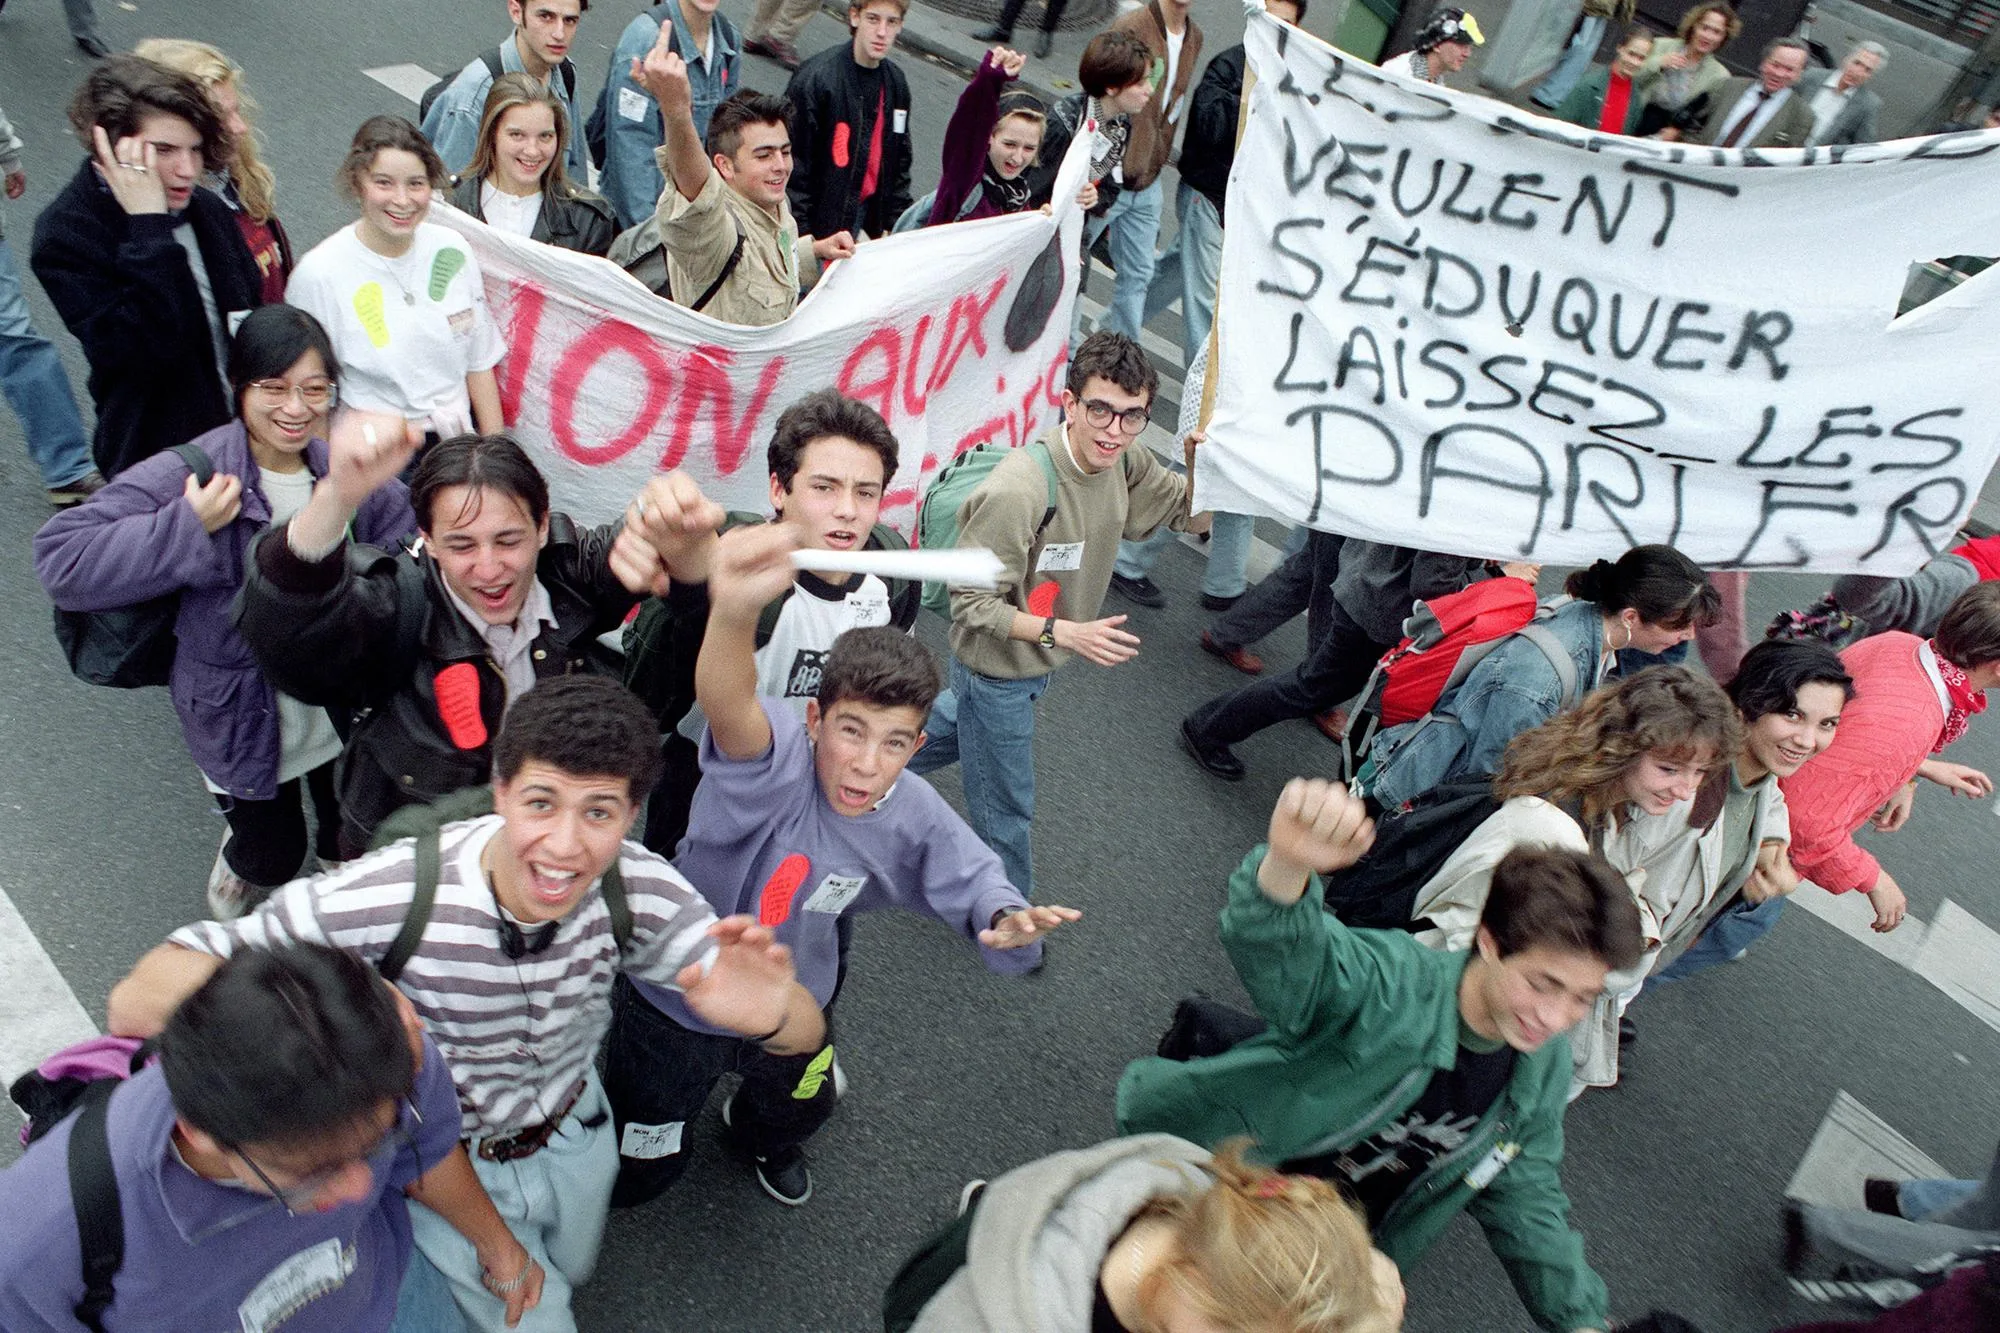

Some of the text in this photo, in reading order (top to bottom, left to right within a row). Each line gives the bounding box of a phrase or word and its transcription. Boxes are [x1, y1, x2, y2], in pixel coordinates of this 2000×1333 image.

[1283, 116, 1740, 248] VEULENT
[836, 268, 1011, 428] AUX
[1257, 215, 1794, 380] S'ÉDUQUER
[1286, 404, 1967, 569] PARLER
